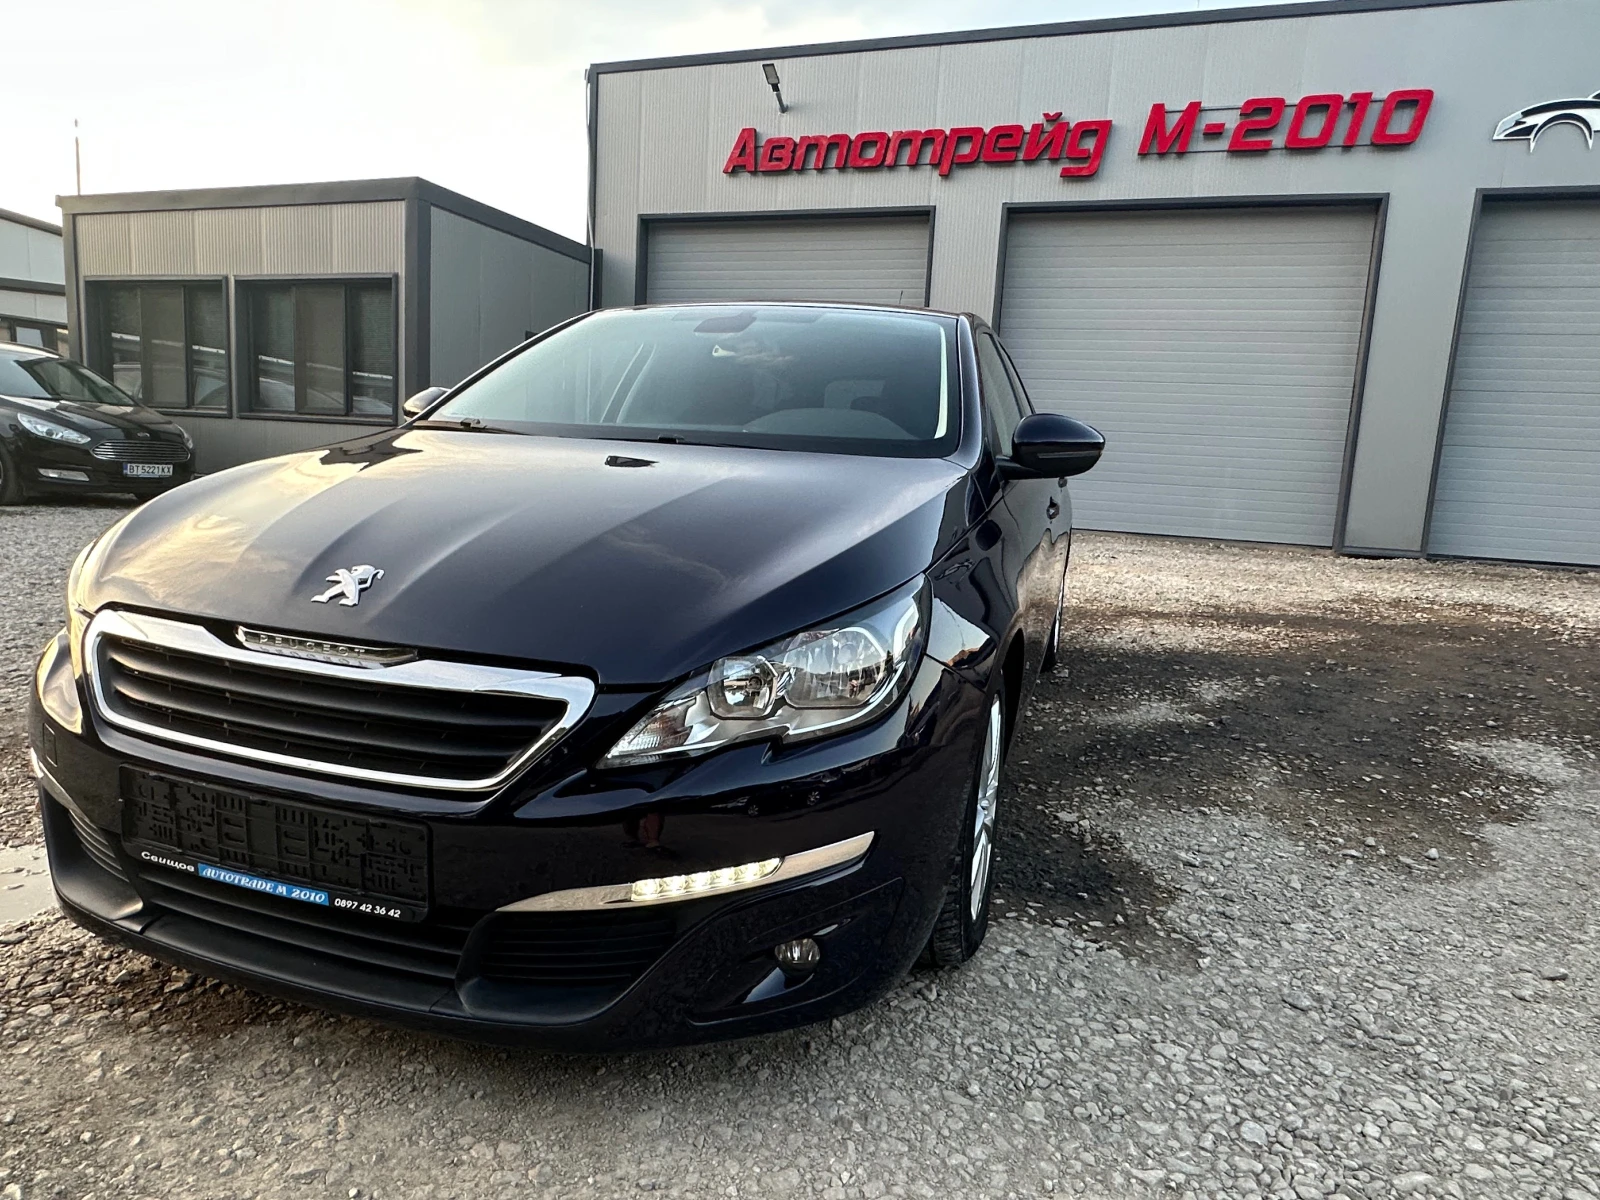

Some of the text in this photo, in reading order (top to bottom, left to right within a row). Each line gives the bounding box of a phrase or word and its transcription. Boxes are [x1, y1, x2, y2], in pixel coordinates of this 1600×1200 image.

[141, 465, 160, 474] 5221
[259, 634, 366, 657] PEUGEOT
[141, 851, 195, 872] Свищов
[203, 868, 273, 892] AUTOTRADE
[291, 888, 325, 902] 2010
[334, 898, 402, 919] 0897 42 36 42
